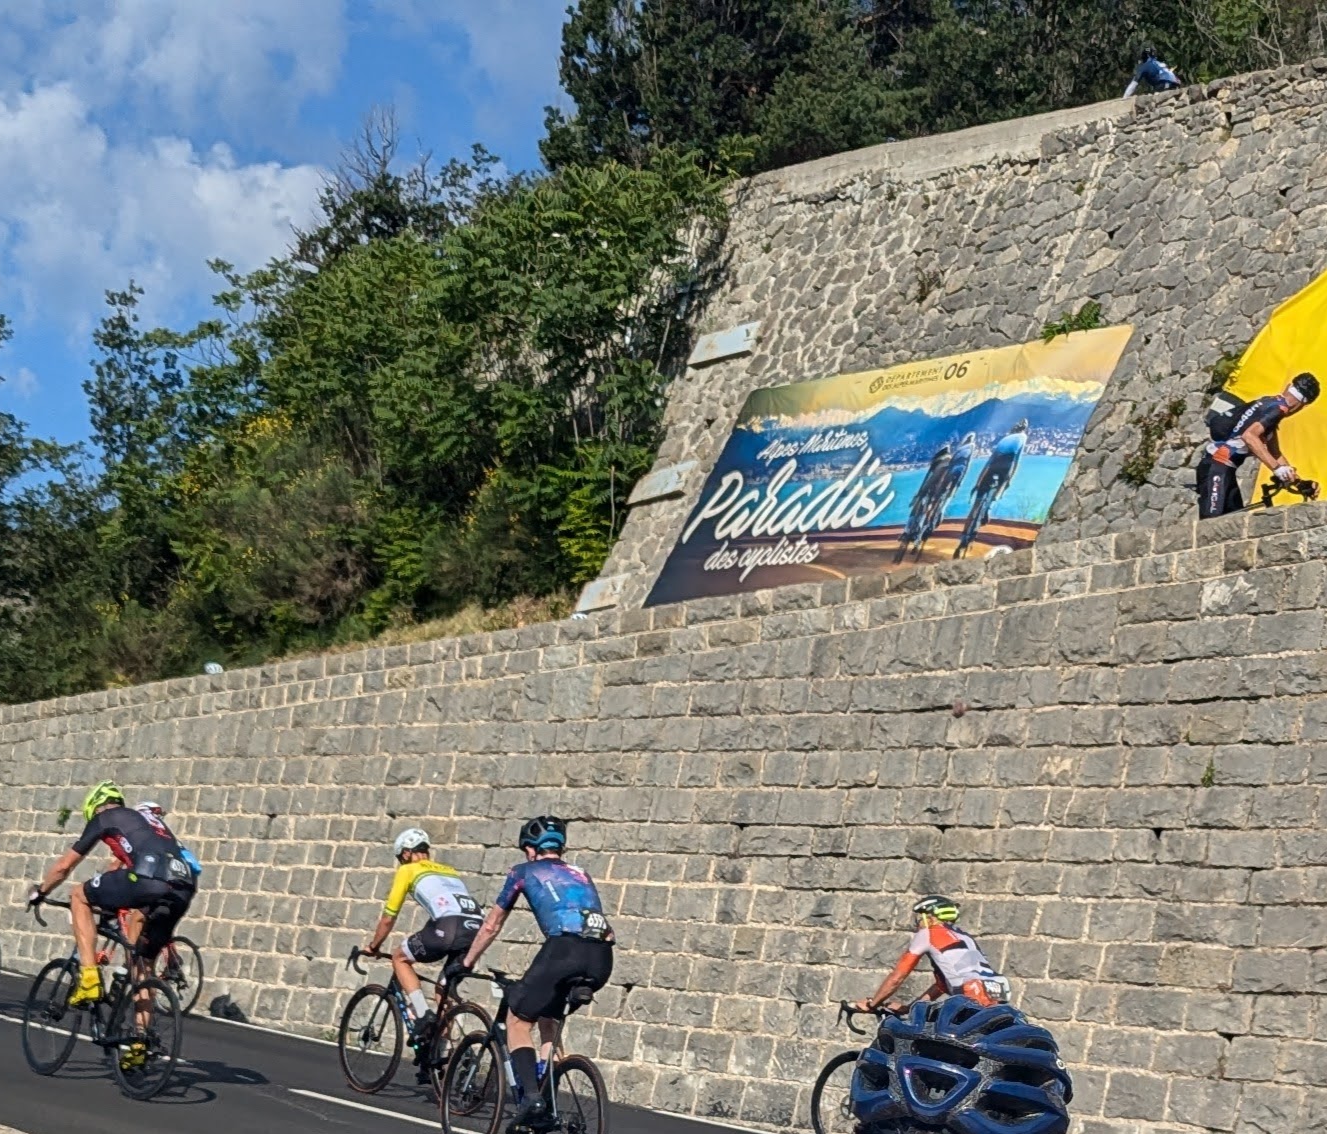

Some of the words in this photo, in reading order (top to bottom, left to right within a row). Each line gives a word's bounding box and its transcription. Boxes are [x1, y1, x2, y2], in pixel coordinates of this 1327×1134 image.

[944, 360, 971, 380] 06
[681, 447, 896, 545] Paradis
[703, 541, 738, 571] des
[738, 534, 820, 583] cyclistes
